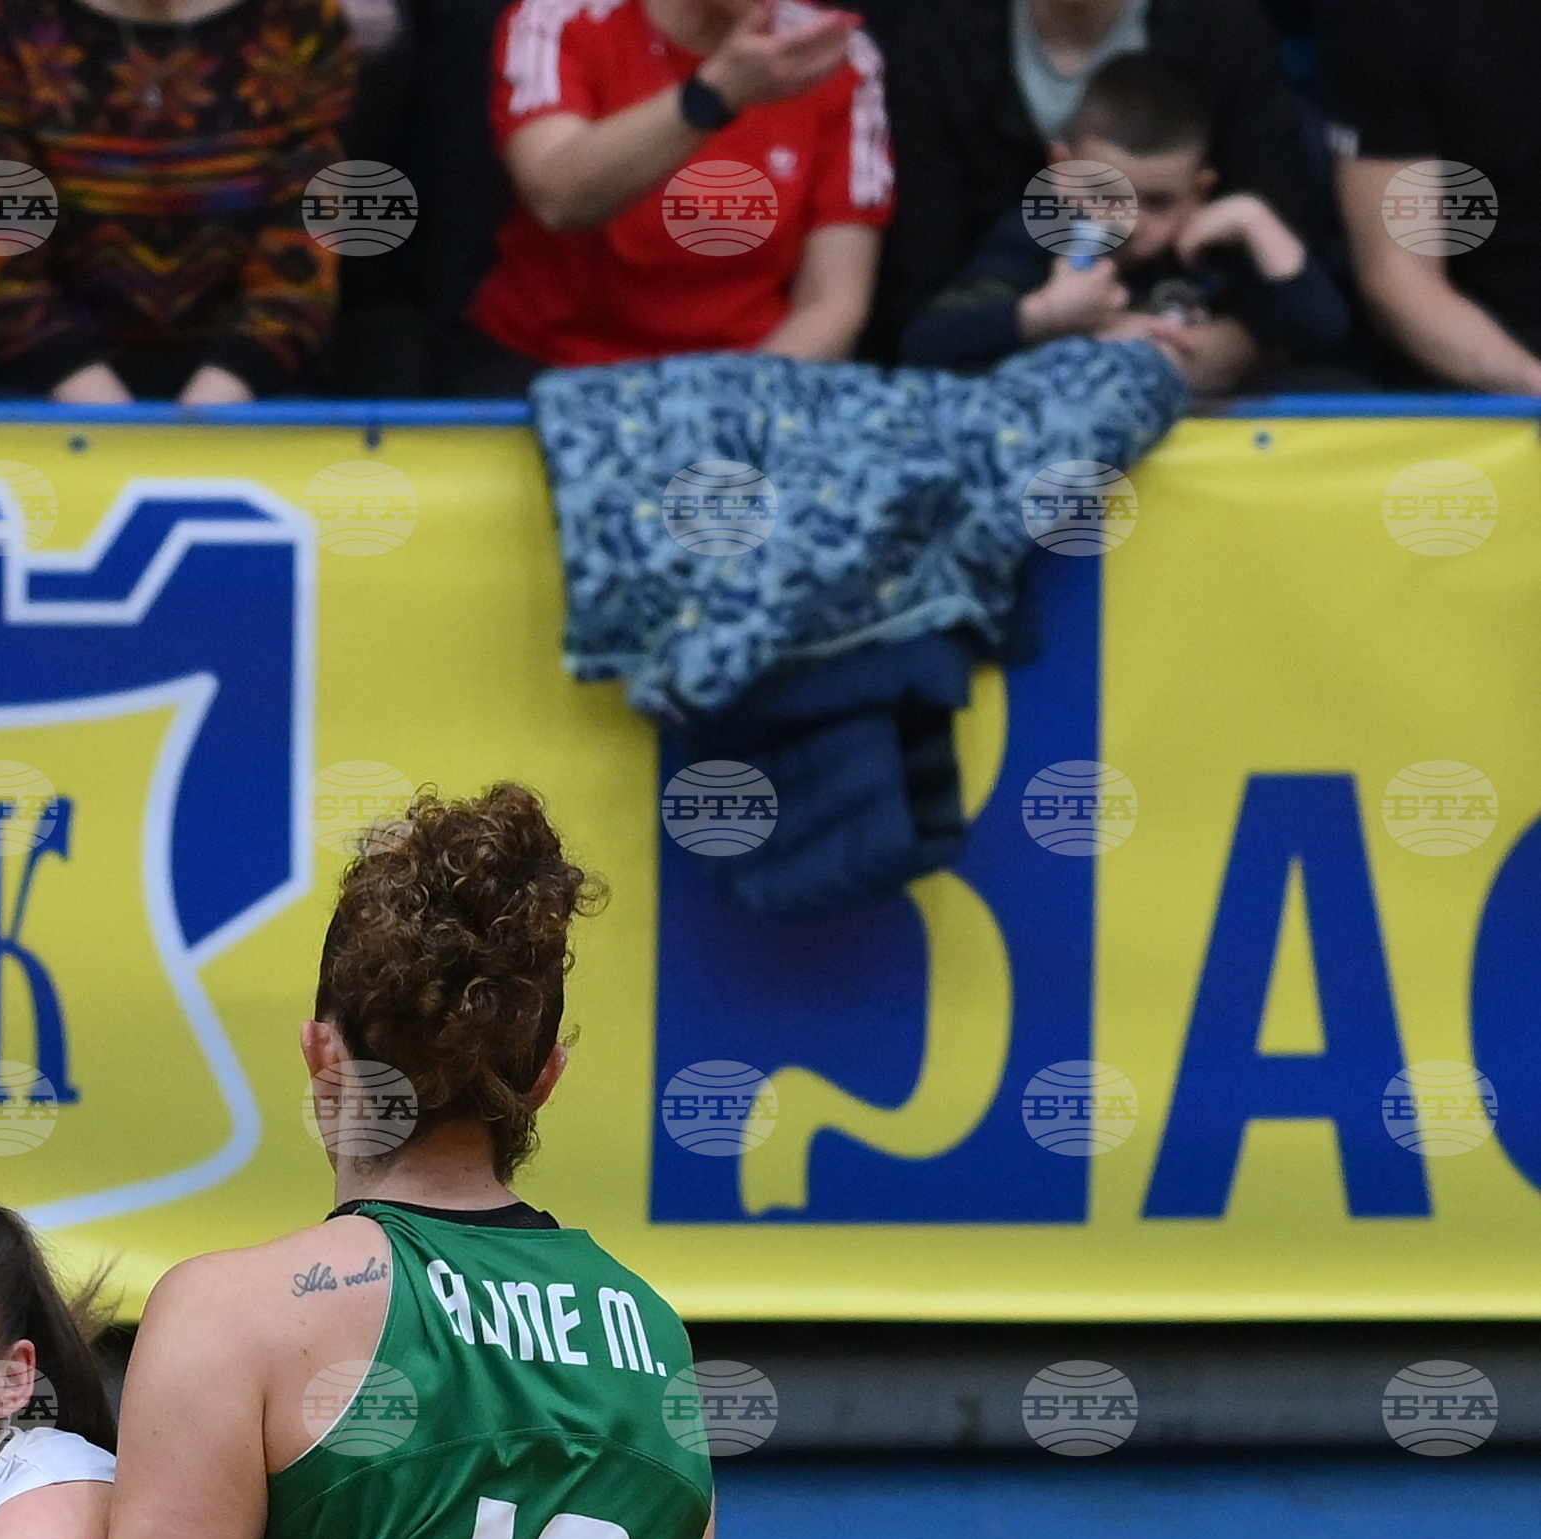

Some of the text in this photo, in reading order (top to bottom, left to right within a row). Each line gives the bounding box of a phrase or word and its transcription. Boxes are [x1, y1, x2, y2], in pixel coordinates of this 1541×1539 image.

[292, 1256, 388, 1298] Alis volat
[598, 1286, 668, 1378] M.
